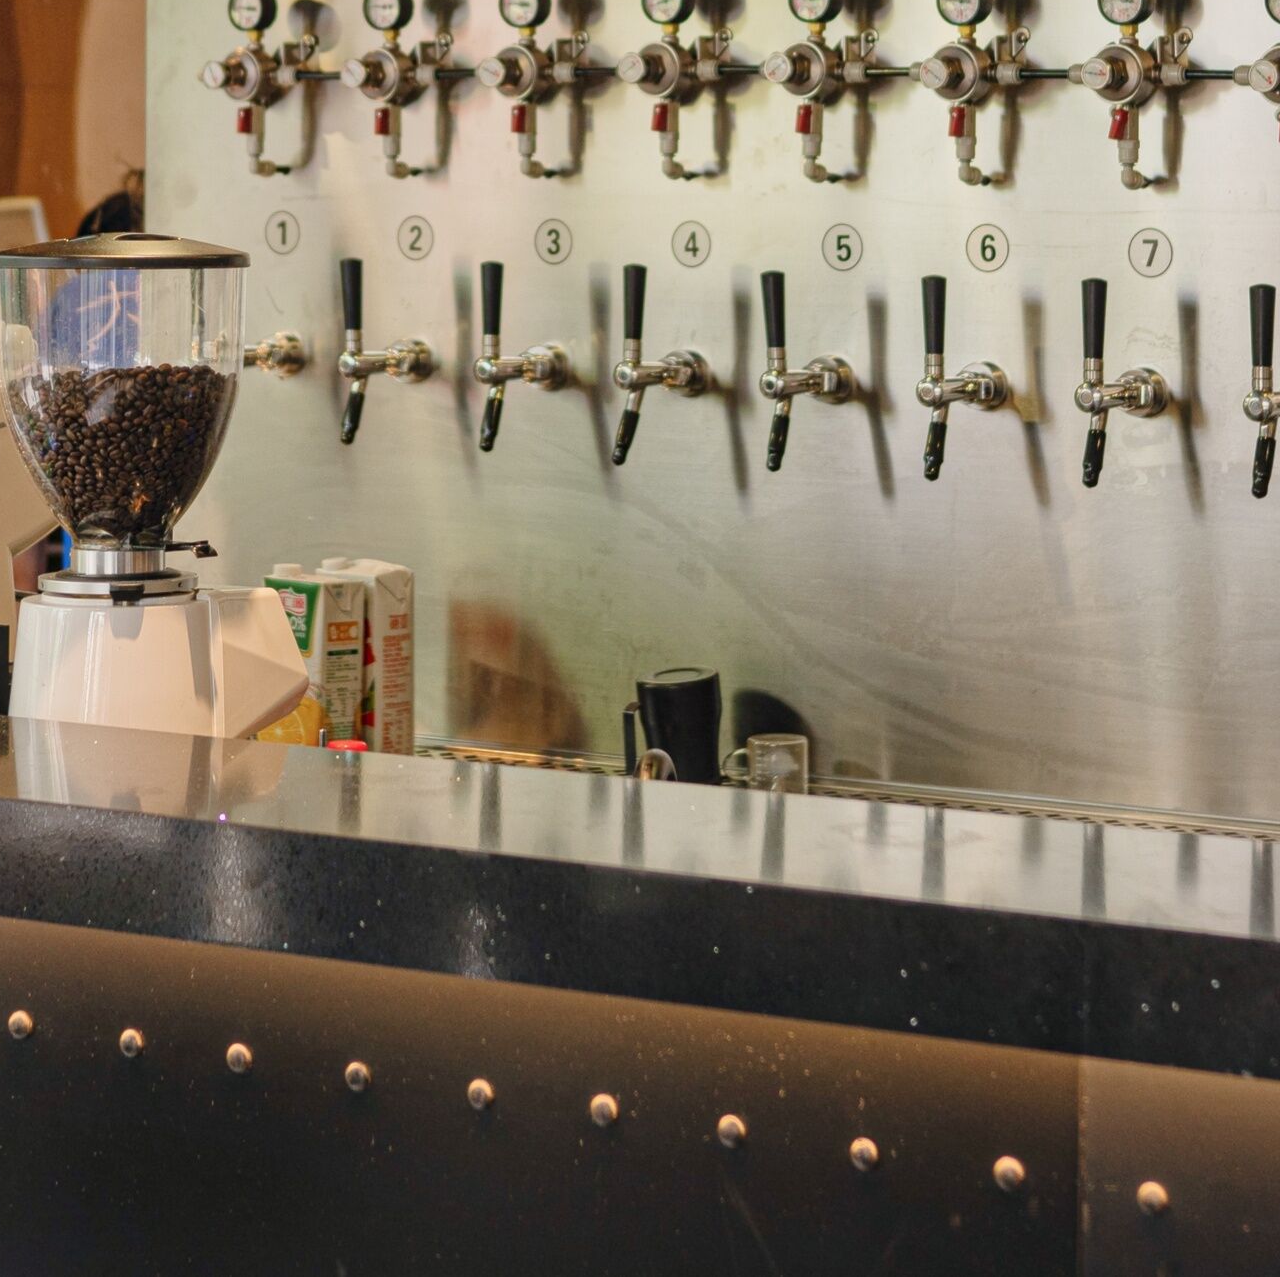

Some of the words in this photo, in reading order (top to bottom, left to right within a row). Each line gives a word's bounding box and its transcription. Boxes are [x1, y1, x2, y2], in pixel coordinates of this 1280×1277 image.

[276, 221, 288, 245] 1
[408, 225, 423, 252] 2
[546, 229, 562, 255] 3
[683, 231, 700, 257] 4
[836, 235, 852, 262] 5
[980, 234, 996, 262] 6
[1141, 240, 1159, 268] 7
